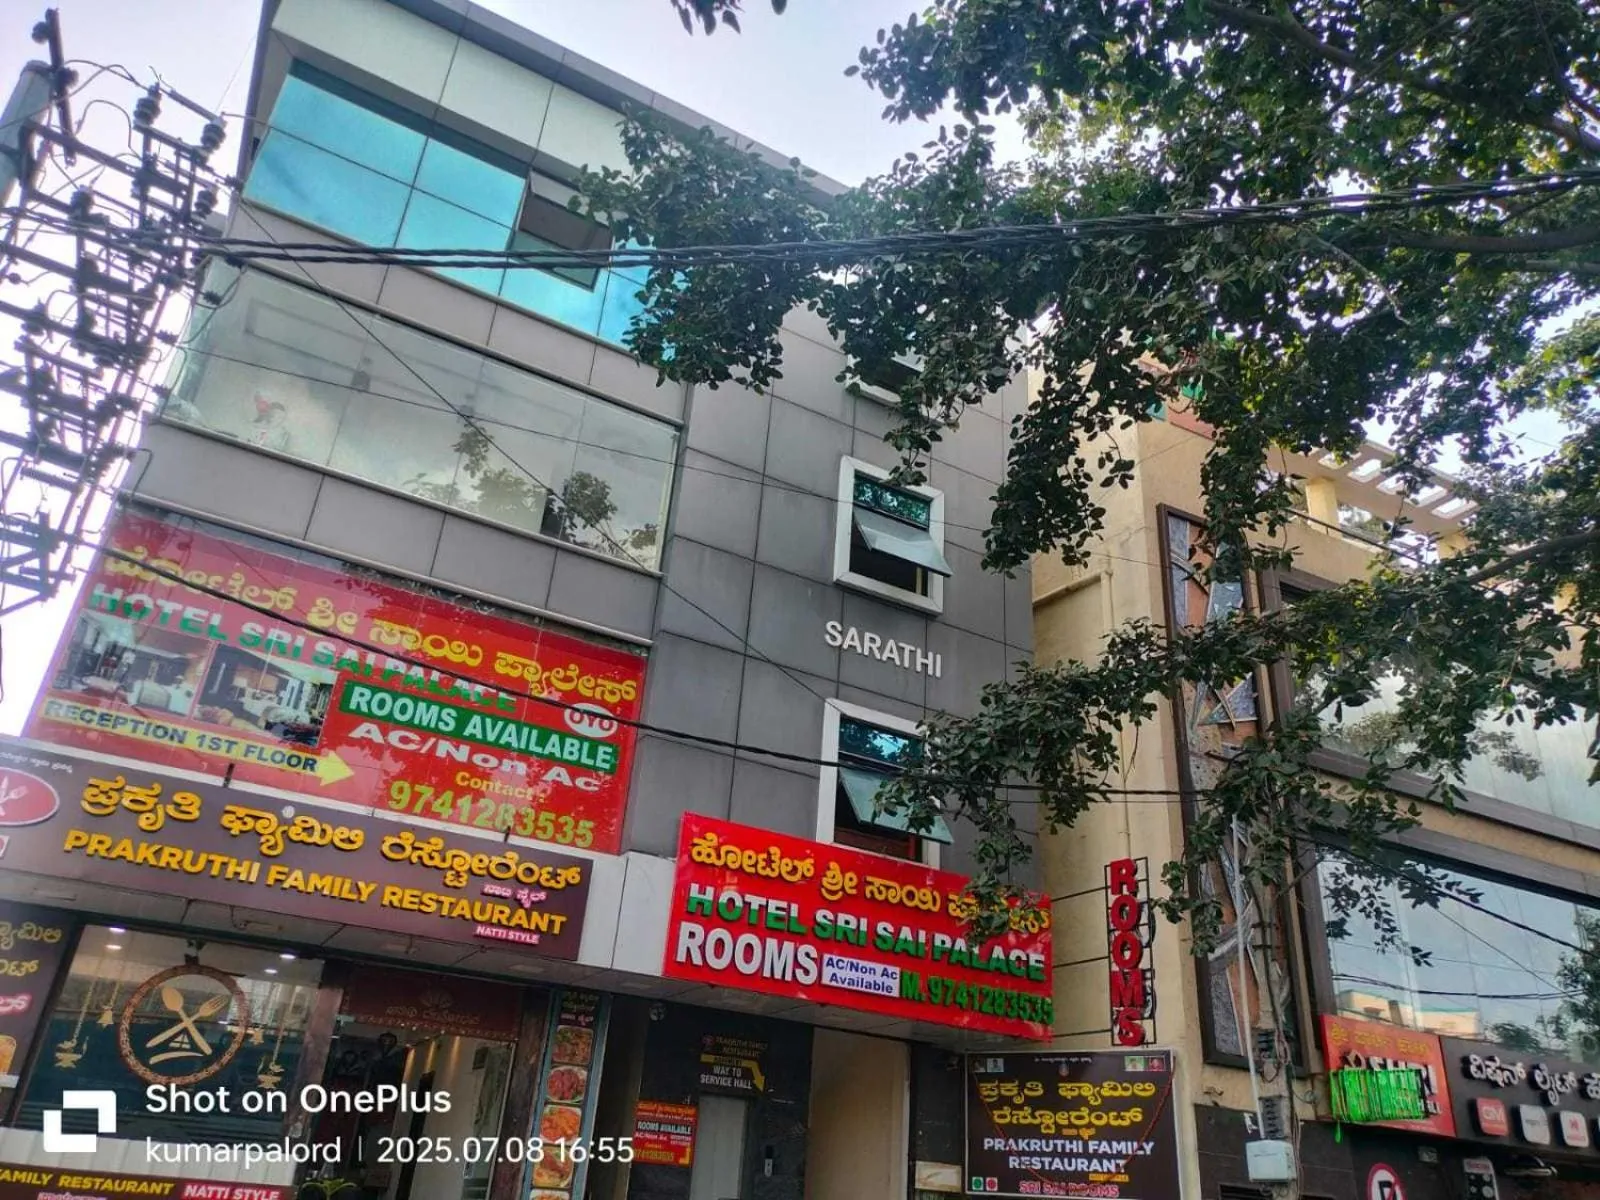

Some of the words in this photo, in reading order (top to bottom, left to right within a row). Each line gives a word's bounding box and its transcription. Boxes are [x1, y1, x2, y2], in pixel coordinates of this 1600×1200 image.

[91, 583, 228, 640] HOTEL
[239, 622, 306, 658] SRI
[312, 640, 377, 677] SAI
[381, 657, 517, 712] PALACE
[824, 620, 942, 678] SARATHI
[43, 699, 188, 745] RECEPTION
[196, 733, 239, 753] 1ST
[243, 743, 319, 773] FLOOR
[349, 685, 457, 733] ROOMS
[463, 714, 616, 772] AVAILABLE
[349, 722, 527, 776] AC/Non
[80, 775, 202, 832] ಪ್ರಕೃತಿ
[381, 830, 581, 889] ರೆಸ್ಟೋರೆಂಟ್
[388, 780, 595, 848] 9741283535
[63, 829, 262, 884] PRAKRUTHI
[265, 863, 377, 903] FAMILY
[382, 885, 568, 936] RESTAURANT
[690, 832, 815, 882] ಹೋಟೆಲ್
[820, 861, 859, 901] ಶ್ರೀ
[864, 875, 941, 913] ಸಾಯಿ
[476, 925, 507, 940] NATTI
[507, 930, 540, 946] STYLE
[675, 920, 819, 986] ROOMS
[686, 882, 808, 935] HOTEL
[813, 908, 868, 946] SRI
[873, 920, 927, 957] SAI
[932, 932, 1046, 982] PALACE
[1109, 858, 1146, 1047] ROOMS
[825, 956, 876, 977] AC/Non
[880, 967, 898, 981] Ac
[829, 972, 893, 994] Available
[700, 1073, 732, 1088] SERVICE
[979, 1080, 1044, 1104] ಪ್ರಕೃತಿ
[984, 1138, 1083, 1154] PRAKRUTHI
[1088, 1140, 1155, 1156] FAMILY
[1008, 1156, 1127, 1173] RESTAURANT
[0, 1168, 53, 1186] AMILY
[58, 1175, 175, 1196] RESTAURANT
[184, 1183, 229, 1200] NATTI
[233, 1188, 281, 1200] STYLE
